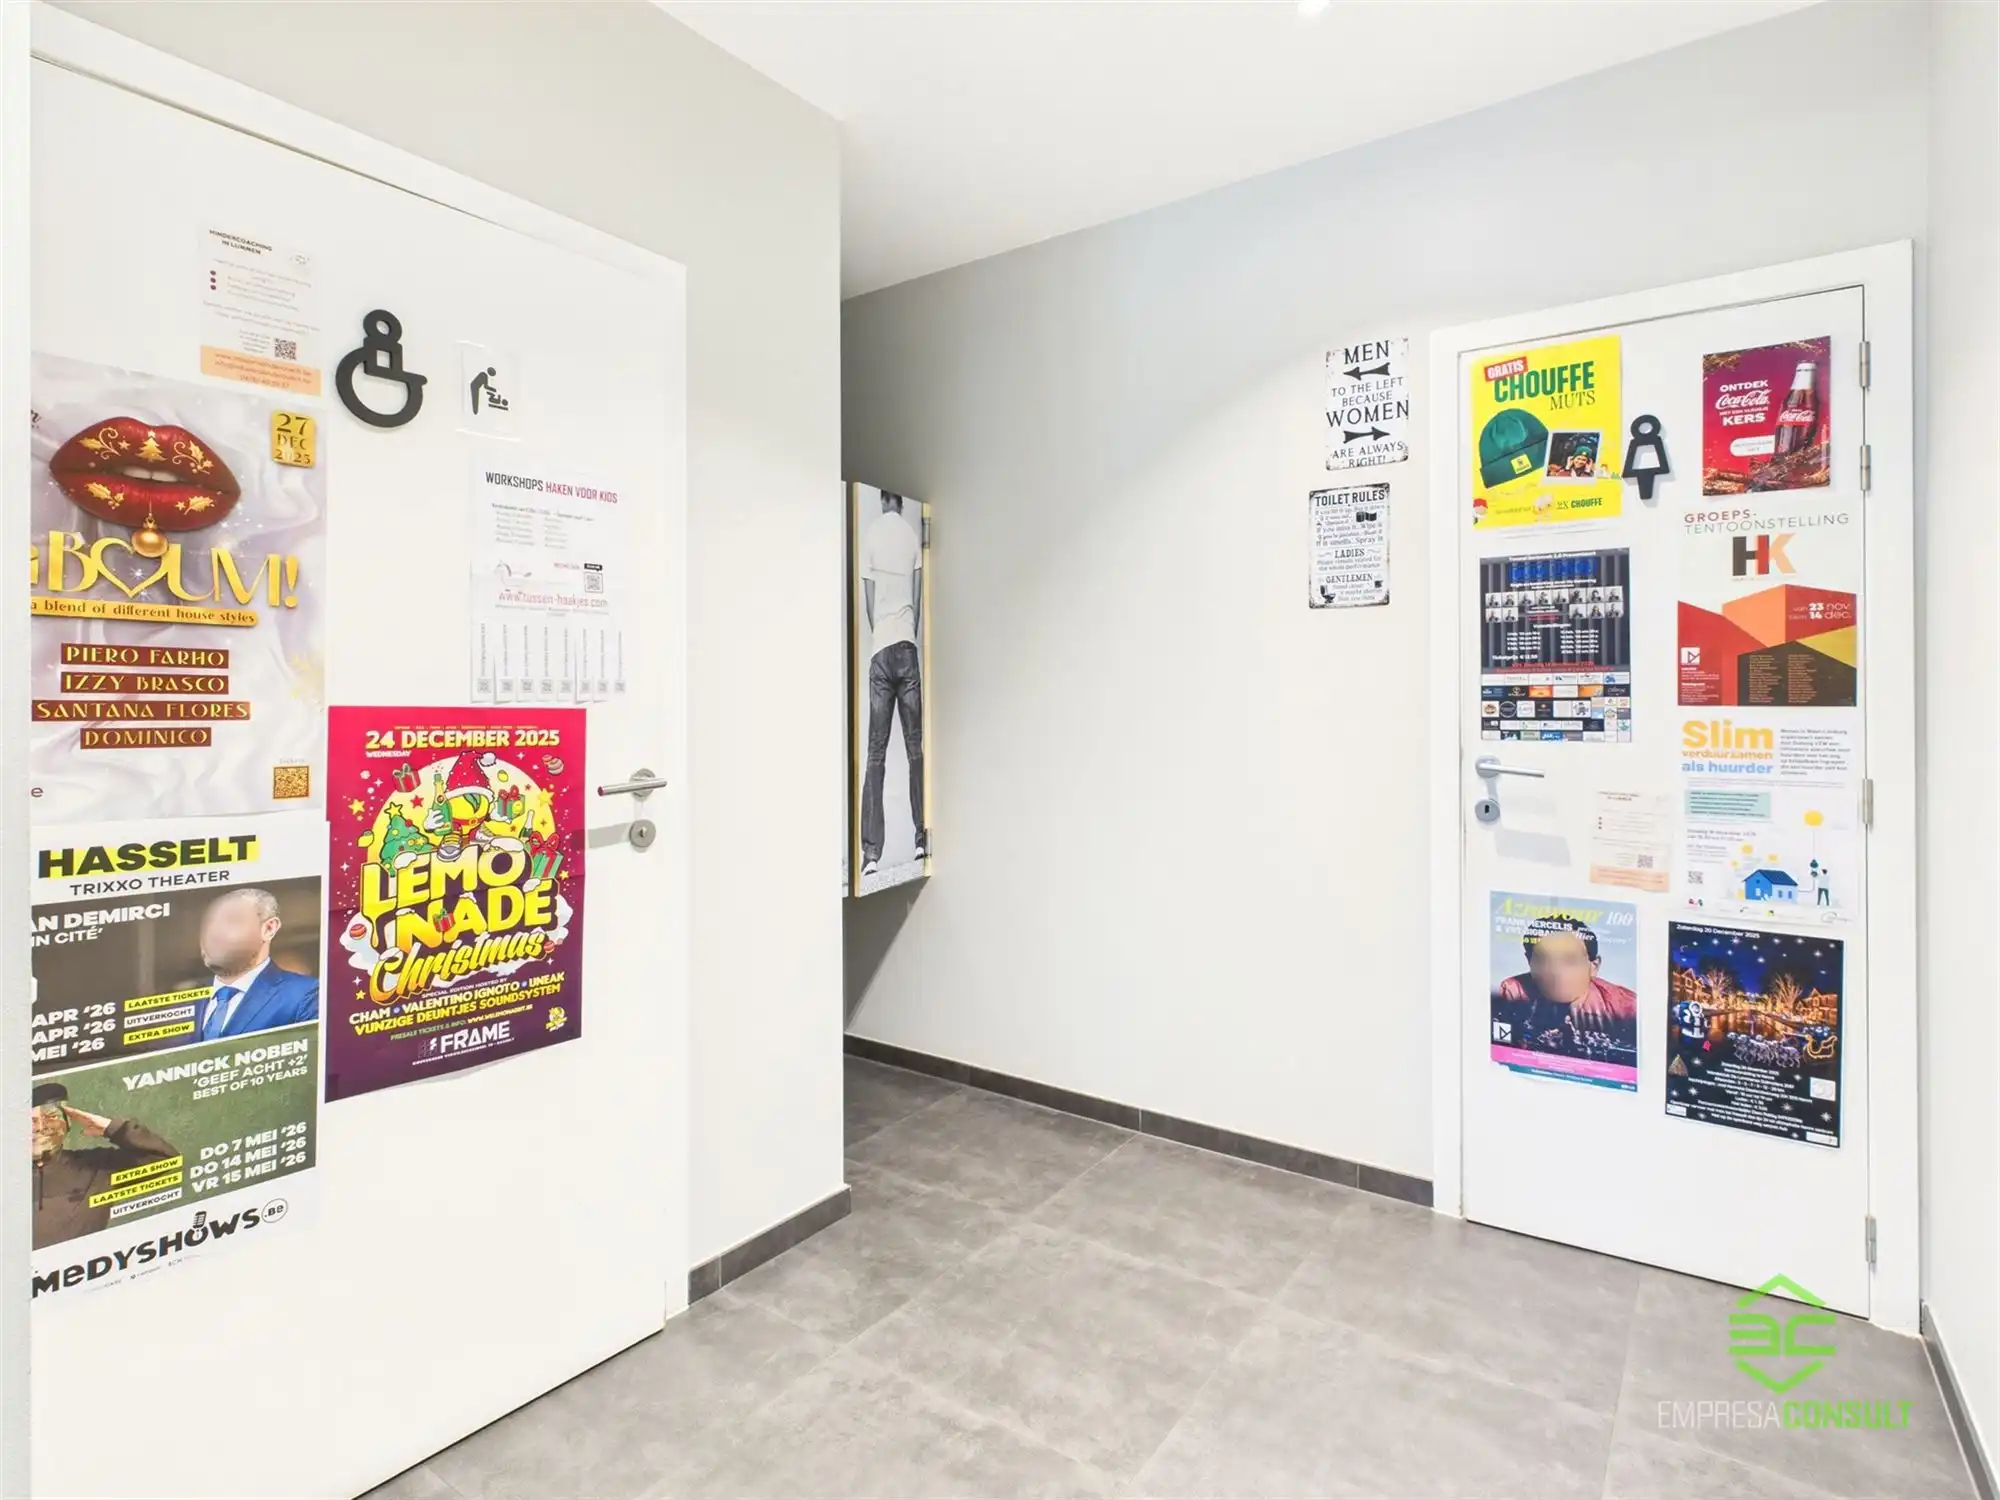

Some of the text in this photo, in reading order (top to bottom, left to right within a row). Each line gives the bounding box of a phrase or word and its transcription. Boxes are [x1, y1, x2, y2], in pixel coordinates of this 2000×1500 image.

[1344, 340, 1390, 364] MEN
[1487, 360, 1524, 379] GRATIS
[1332, 376, 1404, 397] TO THE LEFT
[1494, 361, 1595, 402] CHOUFFE
[1719, 379, 1769, 393] ONTDEK
[1342, 391, 1393, 407] BECAUSE
[1550, 390, 1596, 411] MUTS
[277, 413, 310, 432] 27
[1326, 400, 1408, 428] WOMEN
[1723, 413, 1766, 426] KERS
[277, 433, 307, 450] DEC
[1332, 441, 1404, 459] ARE ALWAYS
[275, 449, 311, 465] 2025
[1348, 456, 1386, 468] RIGHT!
[485, 471, 618, 504] WORKSHOPS HAKEN VOOR KIDS
[1316, 489, 1385, 506] TOILET RULES
[1570, 497, 1602, 508] CHOUFFE
[1684, 513, 1850, 535] TENTOONSTELLING
[1334, 548, 1365, 558] LADIES
[1732, 532, 1798, 576] HK
[1326, 573, 1373, 584] GENTLEMEN
[44, 599, 86, 614] blend
[92, 601, 106, 614] of
[113, 603, 171, 618] different
[176, 607, 215, 620] house
[219, 610, 255, 624] styles
[1808, 602, 1824, 611] 23
[1808, 610, 1853, 620] 14 dec.
[66, 646, 225, 666] PIERO FARHO
[65, 674, 225, 692] IZZY BRASCO
[36, 702, 248, 719] SANTANA FLORES
[84, 729, 208, 747] DOMINICO
[365, 729, 561, 749] 24 DECEMBER 2025
[1682, 719, 1773, 750] Slim
[1682, 749, 1773, 760] verduurzamen
[1682, 761, 1773, 774] als huurder
[39, 835, 256, 878] HASSELT
[70, 870, 230, 896] TRIXXO THEATER
[361, 845, 528, 910] LEMO
[64, 902, 171, 929] DEMIRCI
[396, 880, 553, 948] NADE
[1606, 911, 1634, 927] 100
[370, 931, 545, 1005] Christmas
[128, 988, 210, 1009] LAATSTE TICKETS
[349, 972, 564, 1025] CHAM VALENTINO IGNOTO UNEAK
[422, 990, 449, 999] SPECIAL
[450, 984, 475, 994] EDITION
[476, 980, 499, 990] HOSTED
[31, 1008, 78, 1029] APR
[126, 1007, 193, 1027] UITVERKOCHT
[355, 983, 560, 1036] VUNZIGE DEUNTJES SOUNDSYSTEM
[31, 1028, 78, 1047] APR
[128, 1023, 190, 1042] EXTRA SHOW
[440, 1021, 510, 1054] FRAME
[31, 1046, 68, 1062] MEI
[122, 1038, 308, 1092] YANNICK NOBEN
[241, 1058, 285, 1077] ACHT
[192, 1065, 308, 1100] BEST OF 10 YEARS
[200, 1145, 228, 1161] DO
[232, 1139, 242, 1152] 7
[245, 1129, 277, 1149] MEI
[115, 1158, 179, 1182] EXTRA SHOW
[189, 1161, 217, 1179] DO
[221, 1155, 242, 1171] 14
[245, 1144, 277, 1164] MEI
[192, 1178, 219, 1194] VR
[222, 1170, 242, 1186] 15
[245, 1160, 277, 1180] MEI
[93, 1174, 179, 1205] LAATSTE TICKETS
[112, 1189, 180, 1217] UITVERKOCHT
